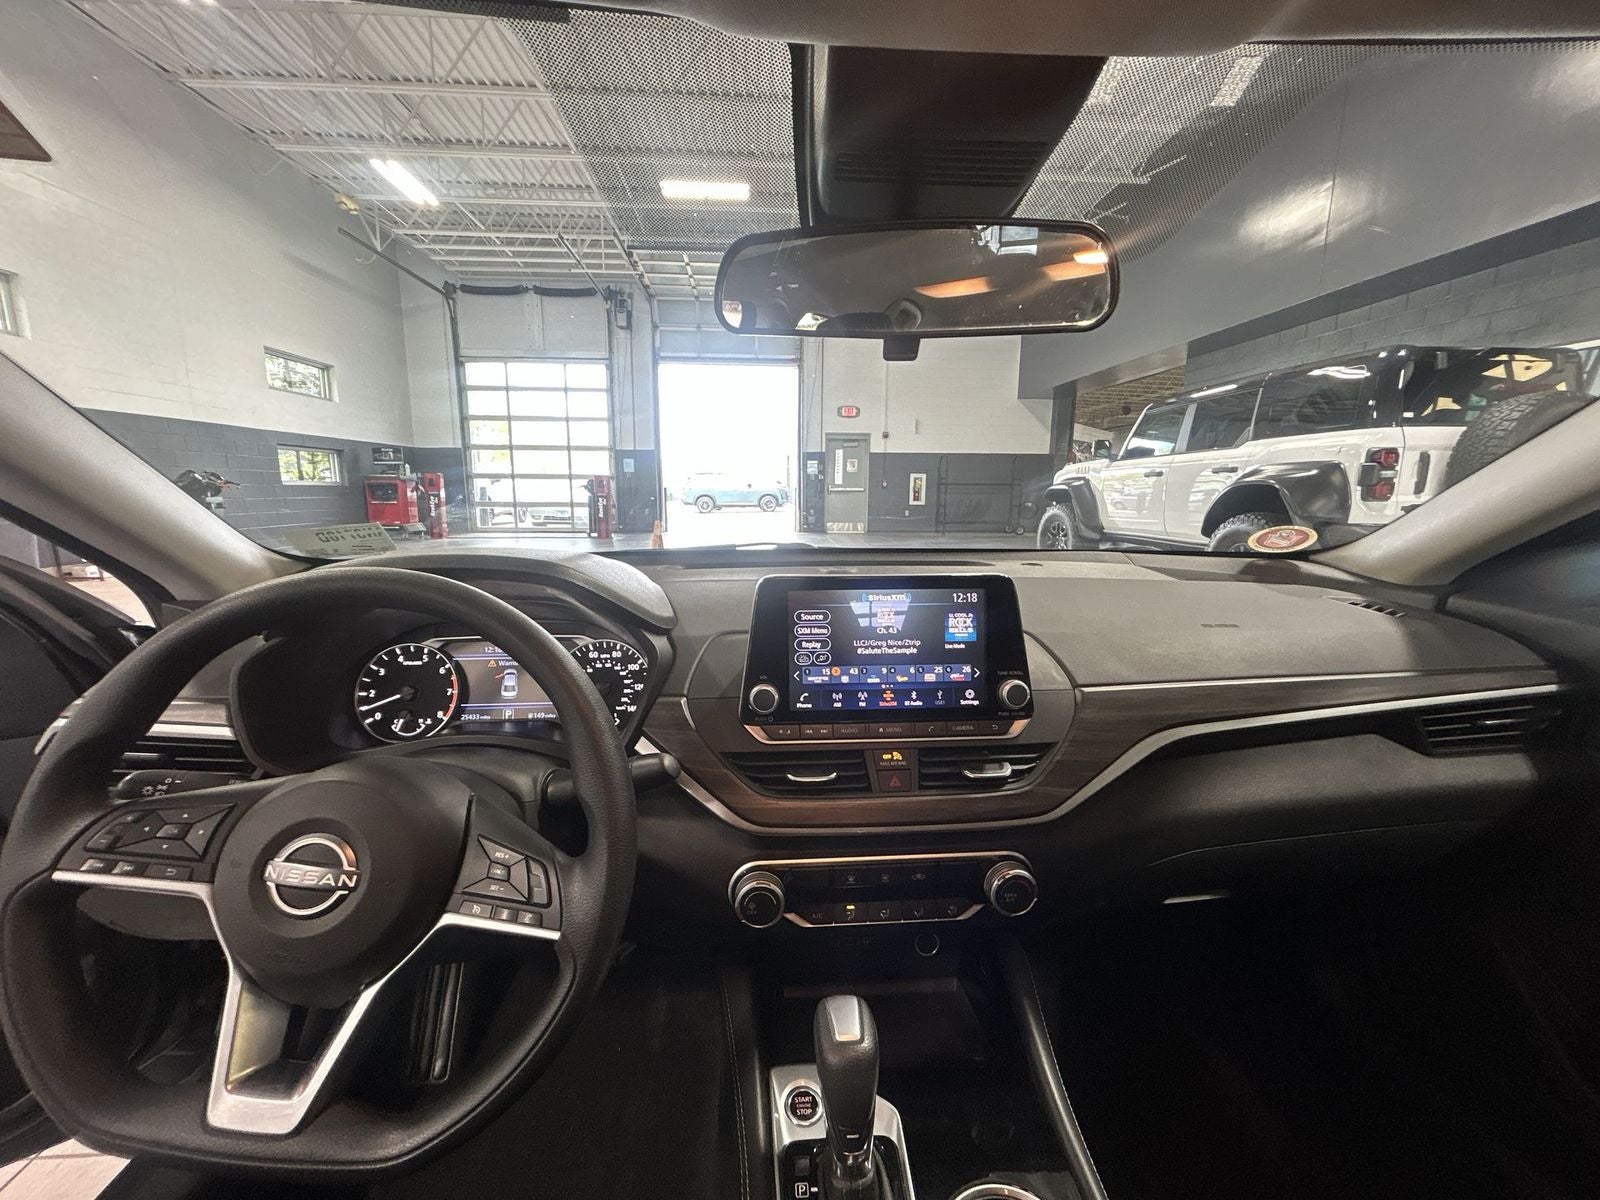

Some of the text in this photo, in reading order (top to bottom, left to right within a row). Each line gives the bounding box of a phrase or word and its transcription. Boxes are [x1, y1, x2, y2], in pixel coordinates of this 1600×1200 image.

[952, 592, 978, 602] 12:18
[948, 618, 973, 627] ROCK
[801, 641, 822, 649] Replay
[628, 663, 640, 671] 100
[378, 668, 385, 676] 3
[369, 689, 376, 697] 2
[374, 712, 382, 720] 0
[264, 864, 357, 888] NISSAN
